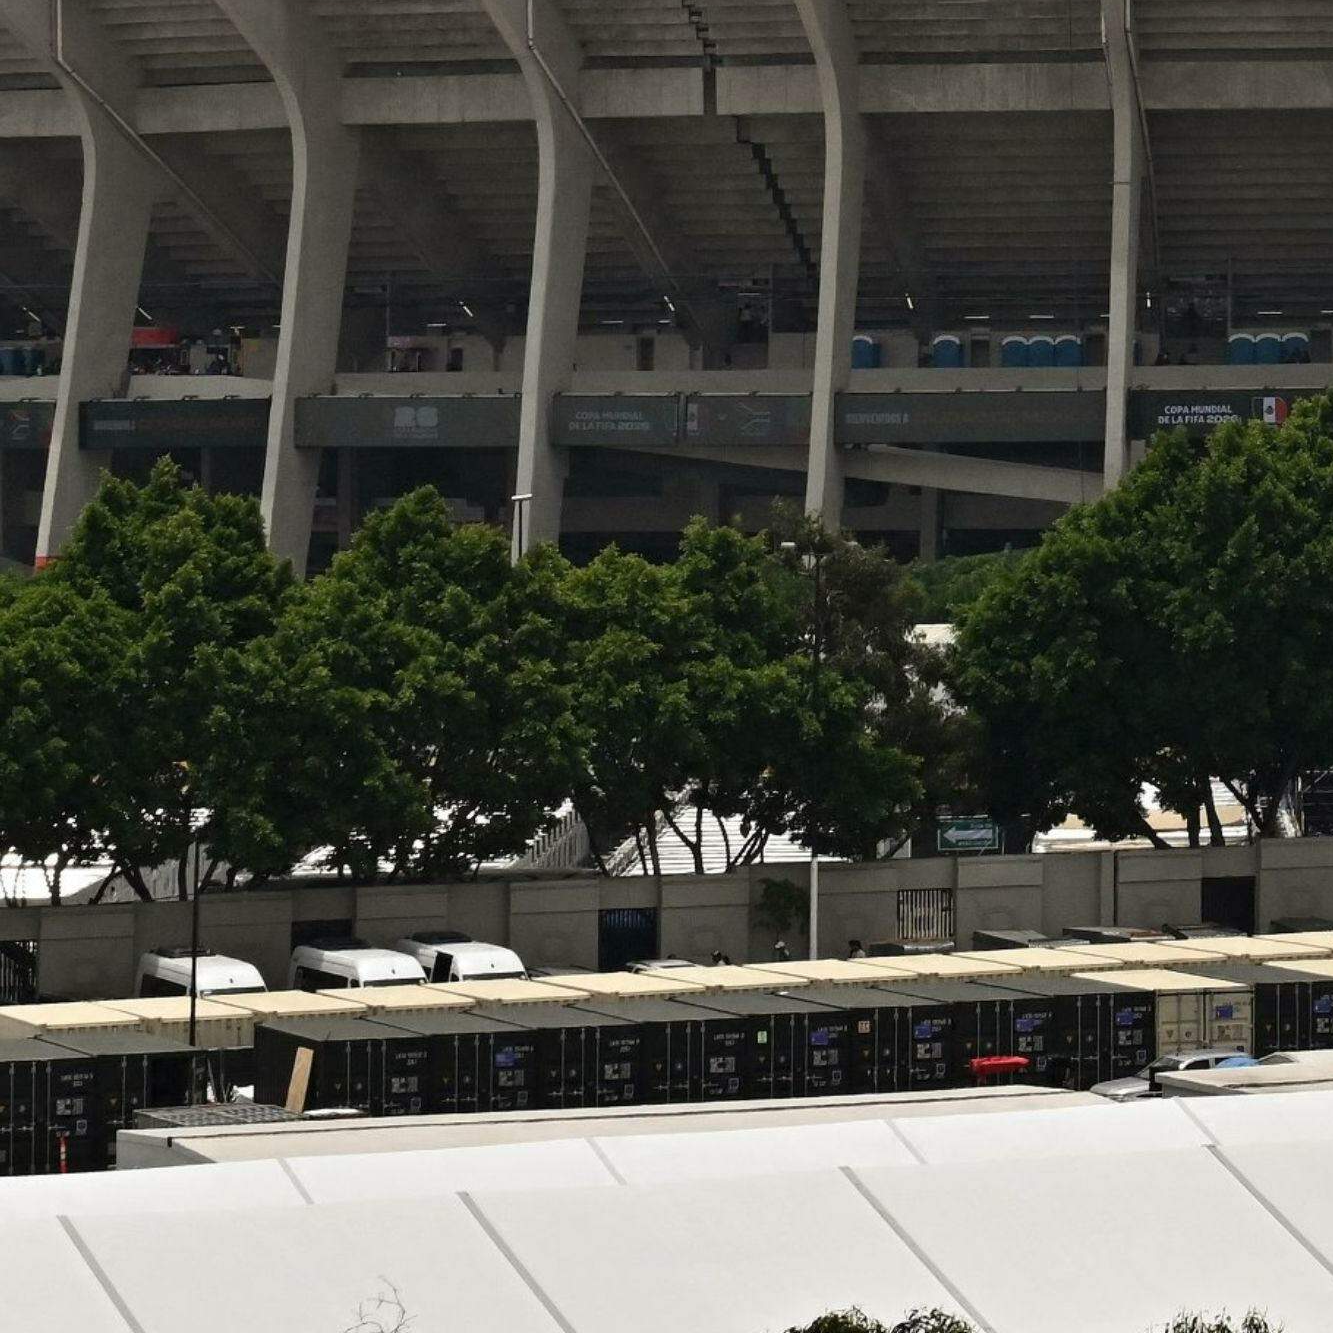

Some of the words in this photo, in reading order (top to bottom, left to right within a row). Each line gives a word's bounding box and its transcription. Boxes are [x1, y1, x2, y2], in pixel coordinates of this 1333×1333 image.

[1164, 405, 1189, 414] COPA
[1190, 405, 1232, 413] MUNDIAL
[1158, 415, 1170, 424] DE
[1171, 415, 1184, 424] LA
[1185, 415, 1204, 424] FIFA
